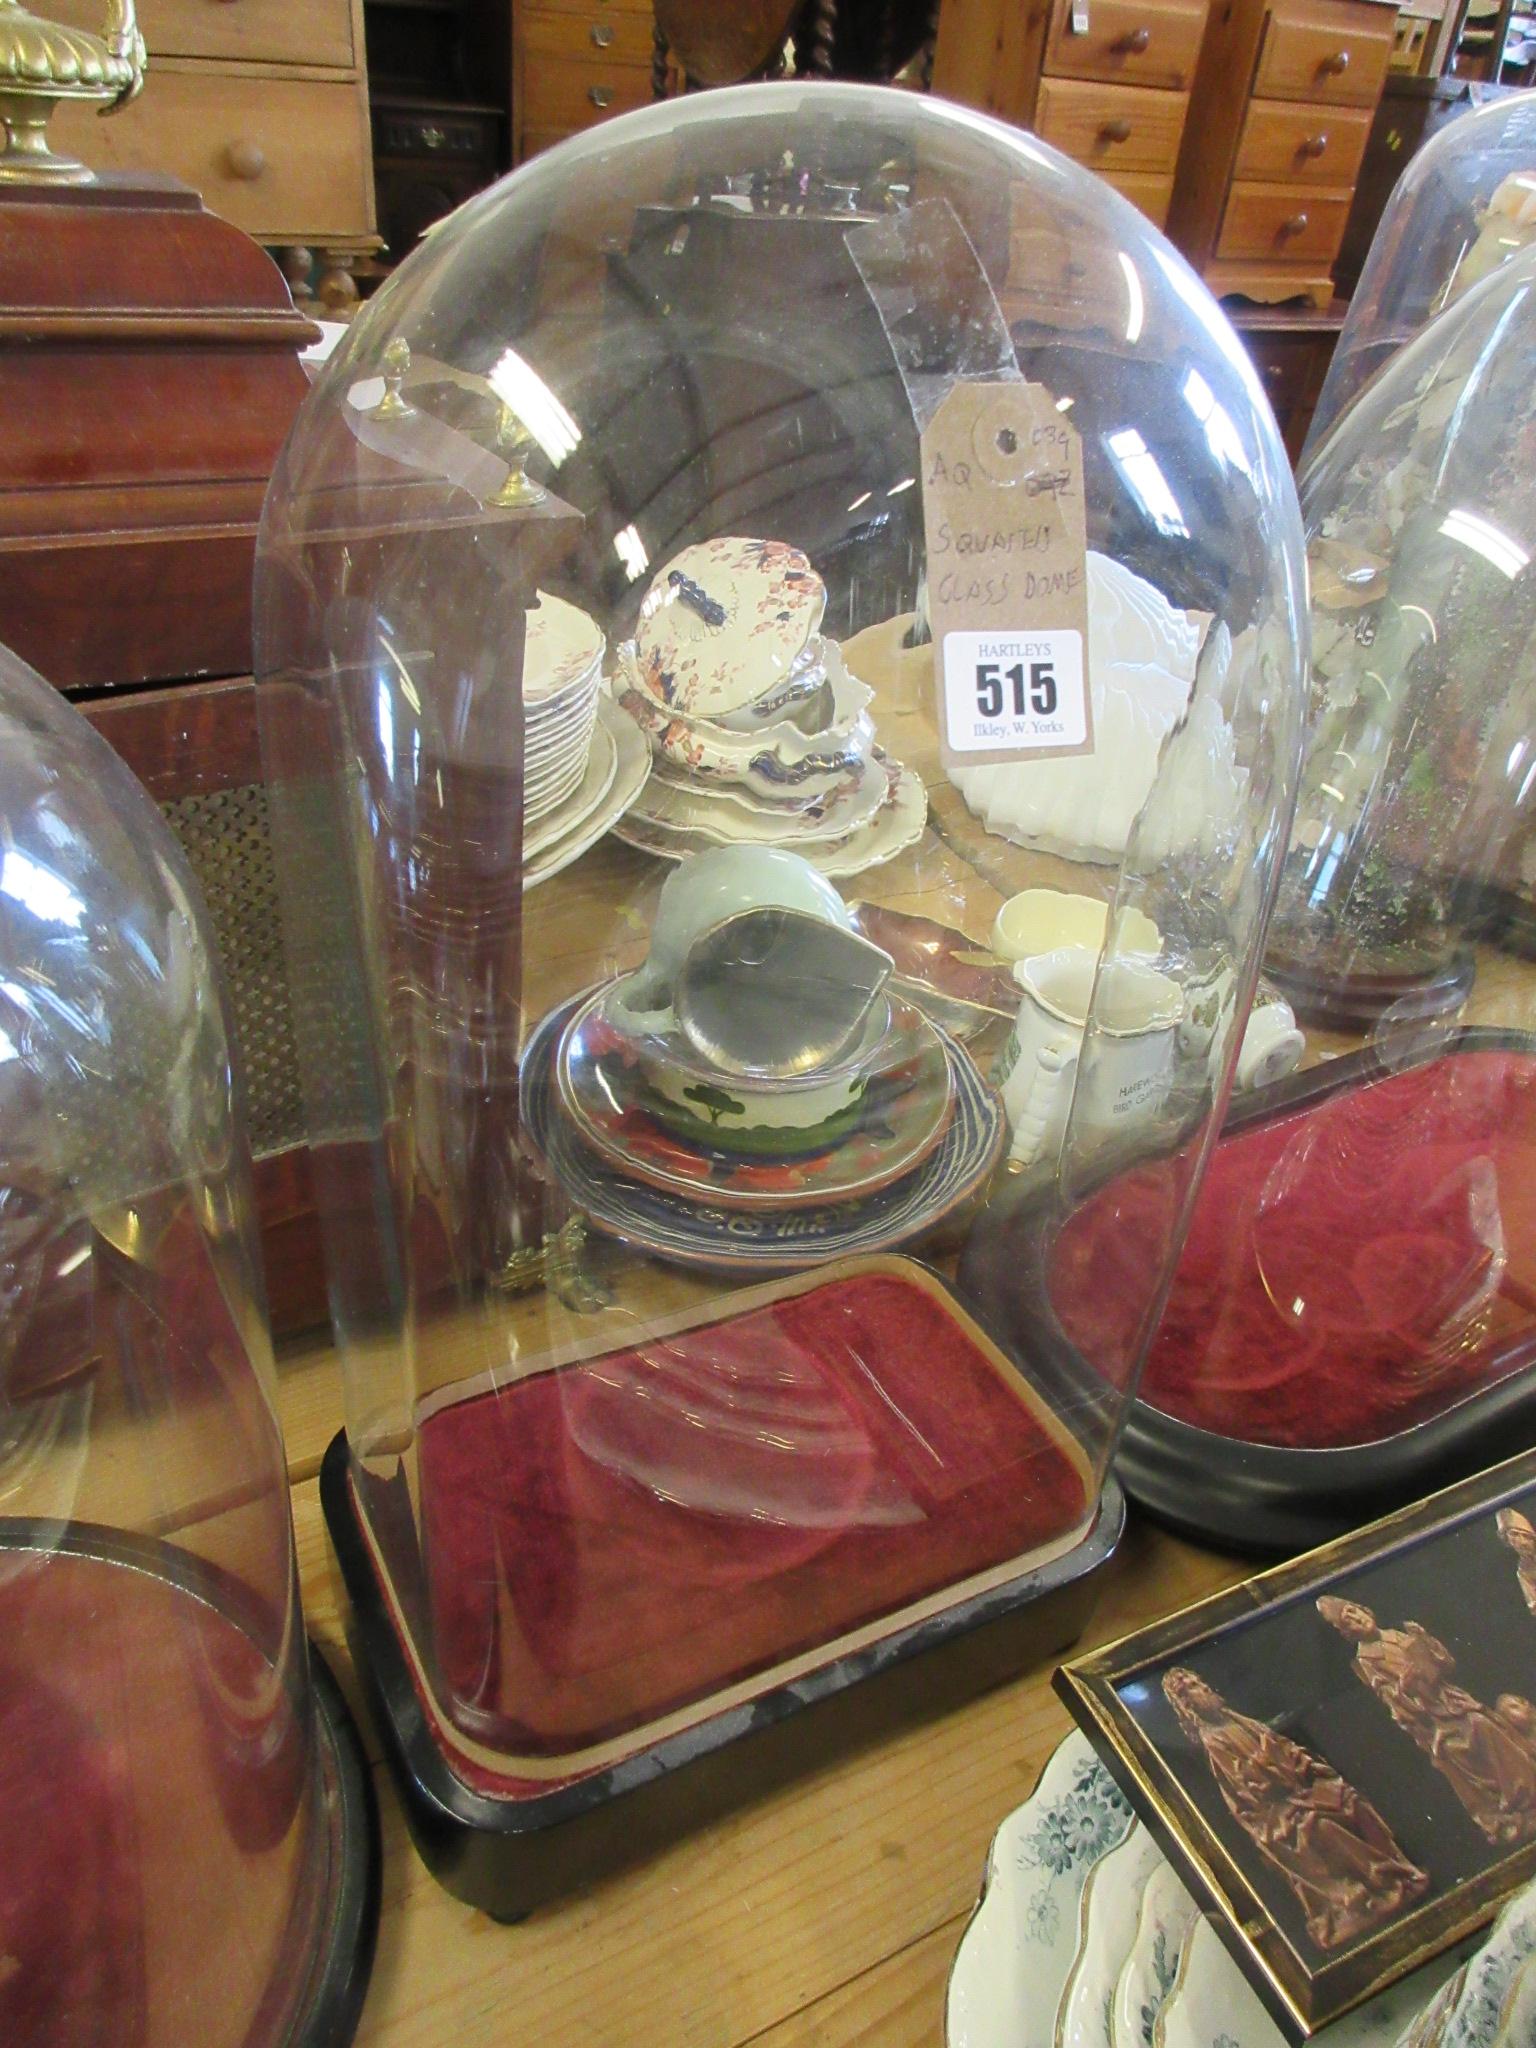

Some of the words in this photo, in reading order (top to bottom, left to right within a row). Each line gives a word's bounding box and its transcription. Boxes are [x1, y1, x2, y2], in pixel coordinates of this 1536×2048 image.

[978, 643, 1052, 657] HARTLEYS
[976, 662, 1058, 717] 515
[1013, 722, 1028, 735] W.
[1031, 720, 1065, 734] Yorks
